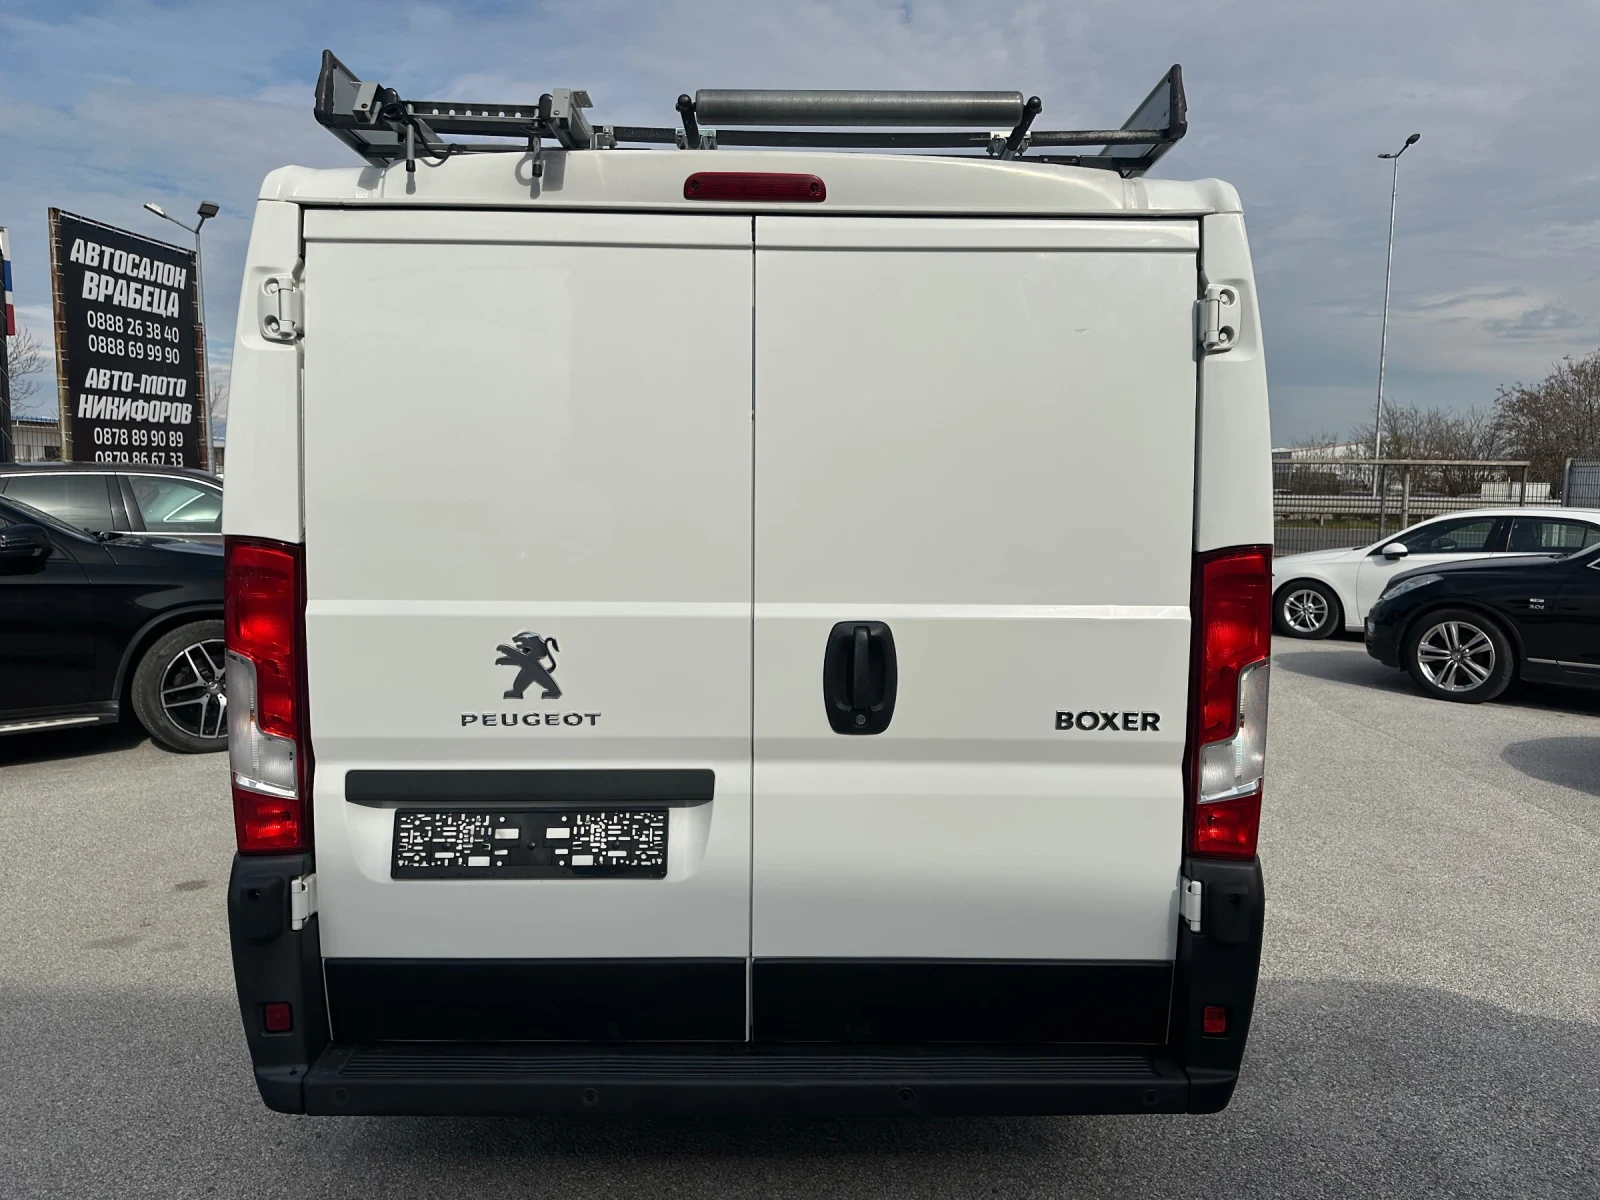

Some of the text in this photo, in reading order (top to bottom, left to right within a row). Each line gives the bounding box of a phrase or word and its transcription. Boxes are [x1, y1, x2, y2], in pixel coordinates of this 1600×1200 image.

[70, 238, 187, 290] АВТОСАЛОН
[82, 270, 179, 318] ВРАБЕЦА
[87, 310, 179, 343] 0888 26 38 40
[88, 334, 180, 364] 0888 69 99 90
[84, 367, 187, 398] АВТО-МОТО
[77, 393, 193, 425] НИКИФОРОВ
[93, 427, 184, 447] 0878 89 90 89
[95, 450, 129, 463] 0879
[151, 452, 166, 465] 67
[169, 452, 184, 468] 33
[461, 712, 602, 727] PEUGEOT
[1055, 709, 1161, 732] BOXER
